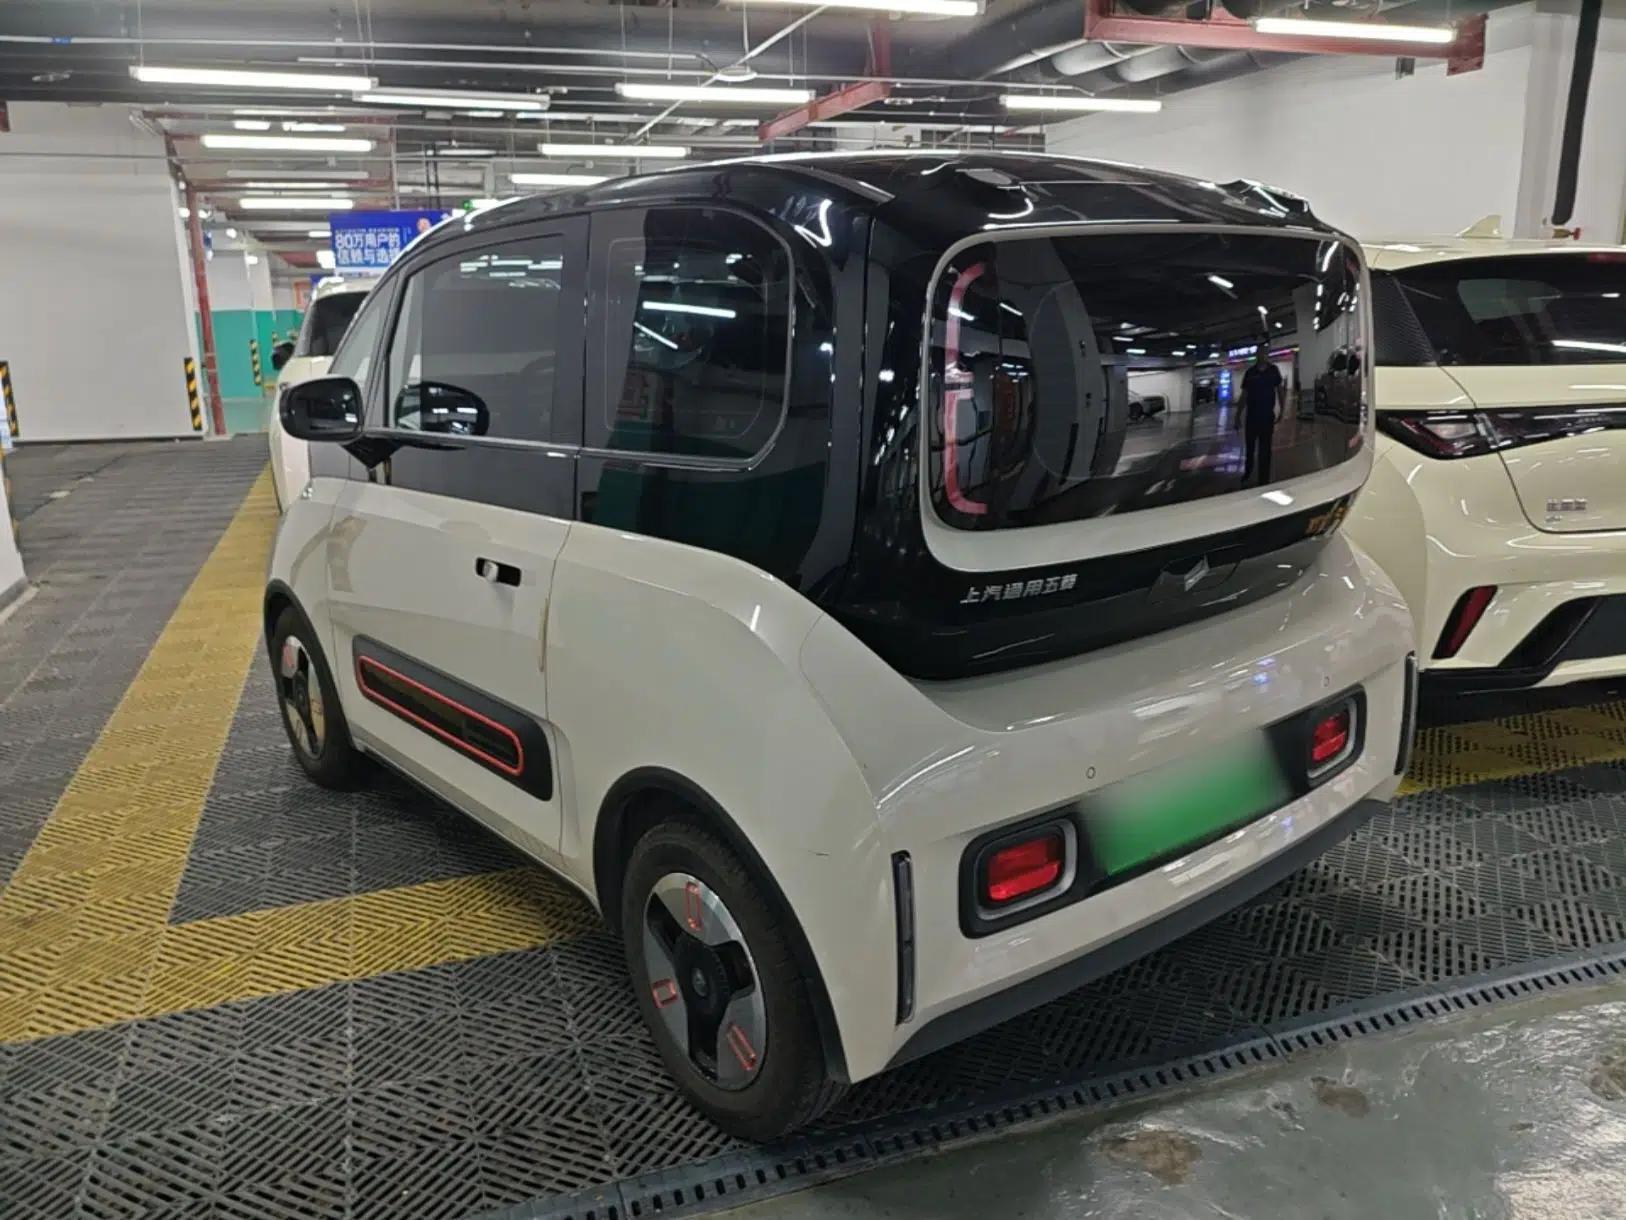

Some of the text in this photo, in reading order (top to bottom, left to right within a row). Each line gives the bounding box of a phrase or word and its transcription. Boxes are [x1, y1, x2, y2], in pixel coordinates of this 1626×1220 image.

[335, 232, 400, 249] 80万用户的
[960, 573, 1078, 604] 上汽通用五菱
